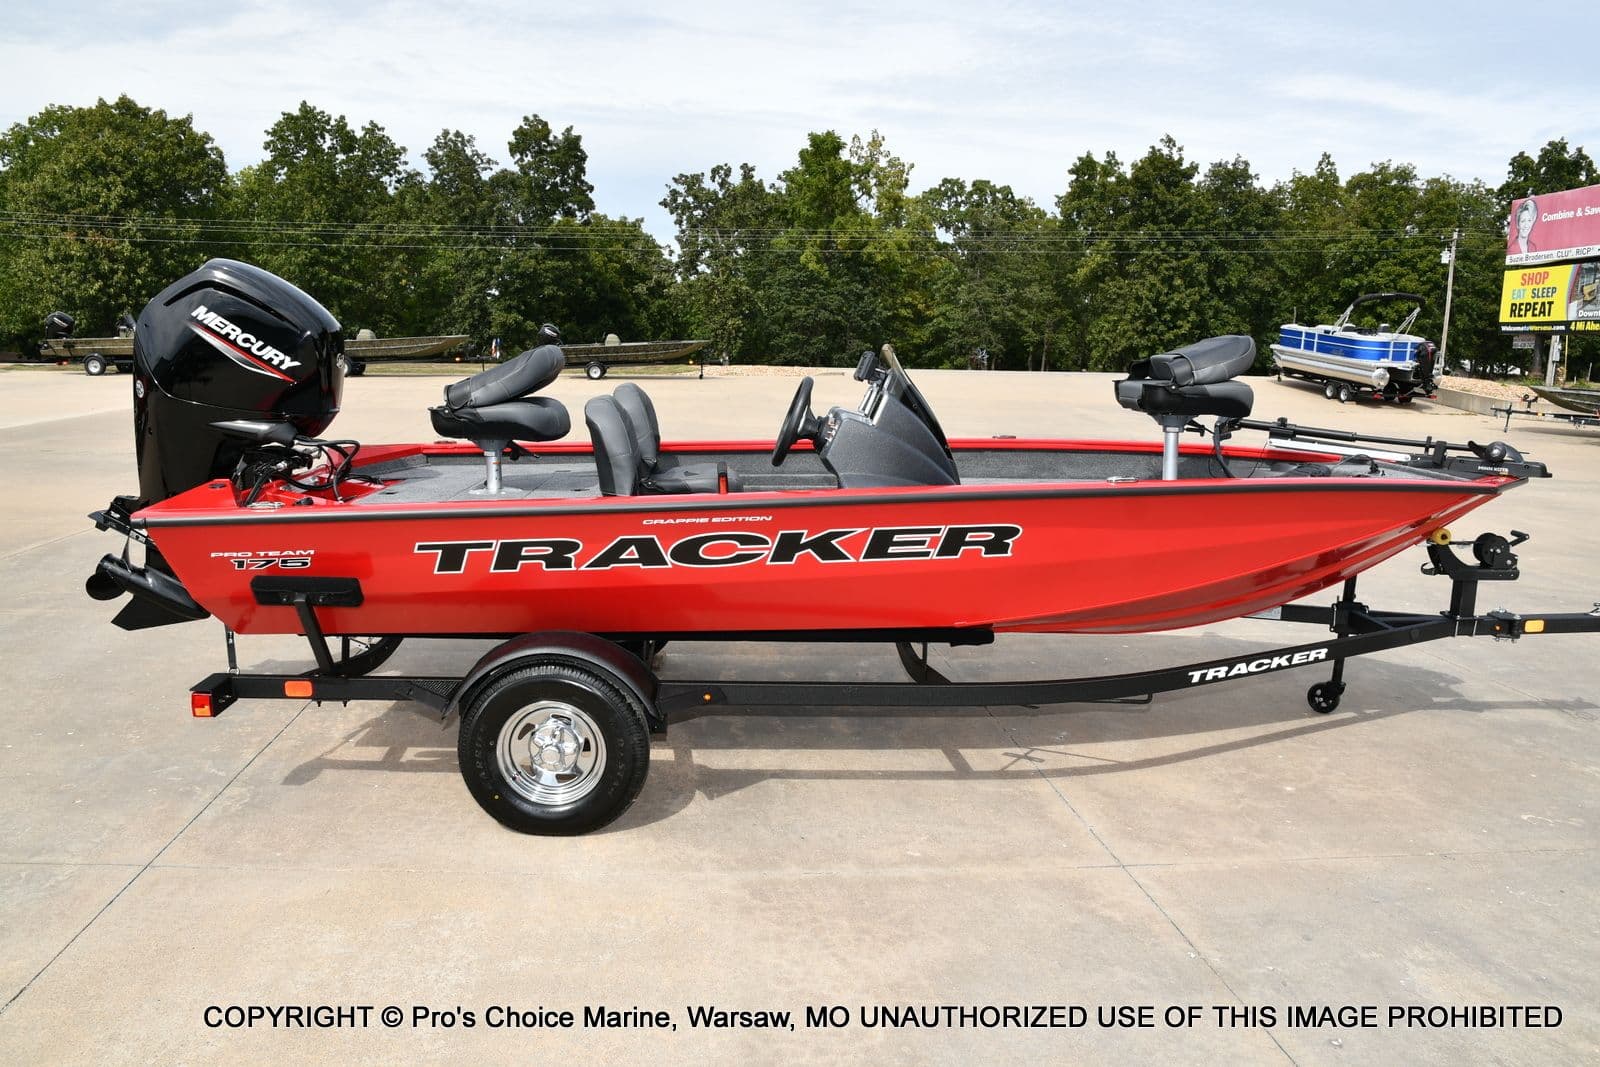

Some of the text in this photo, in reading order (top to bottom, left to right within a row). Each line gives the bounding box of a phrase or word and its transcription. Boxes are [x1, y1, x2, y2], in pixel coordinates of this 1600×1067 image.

[1542, 211, 1575, 222] Combine
[1576, 207, 1583, 217] &
[1520, 271, 1550, 286] SHOP
[1511, 287, 1557, 299] EAT SLEEP
[1509, 301, 1554, 318] REPEAT
[1570, 321, 1576, 331] 4
[1576, 321, 1585, 331] Mi
[190, 305, 301, 370] MERCURY
[643, 515, 772, 525] CRAPPIE EDITION
[256, 549, 315, 557] TEAM
[412, 523, 1023, 575] TRACKER
[230, 557, 312, 570] 175
[1188, 647, 1329, 683] TRACKER
